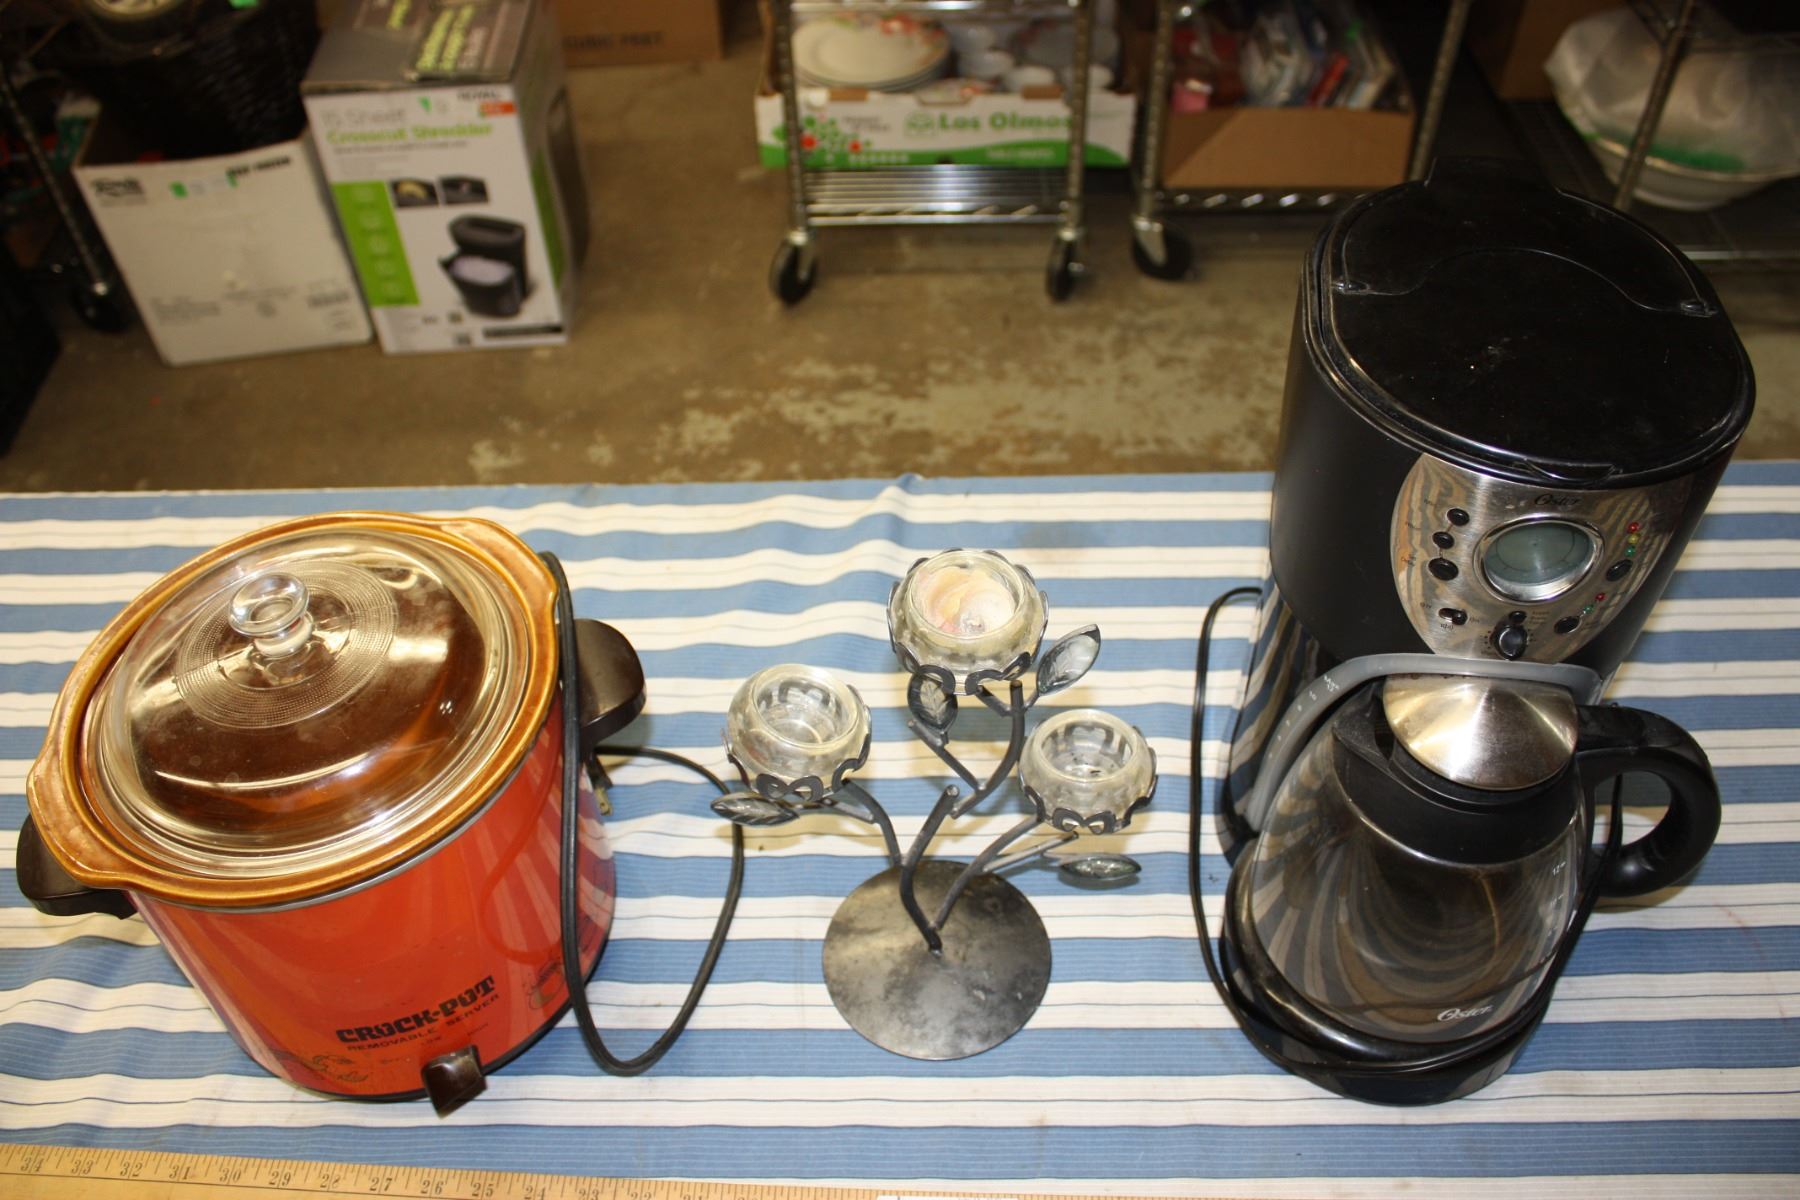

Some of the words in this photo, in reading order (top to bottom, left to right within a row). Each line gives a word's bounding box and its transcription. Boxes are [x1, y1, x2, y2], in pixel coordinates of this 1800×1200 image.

[326, 127, 407, 144] Crosscut
[413, 122, 493, 140] Shredder
[938, 110, 981, 131] Los
[335, 975, 496, 1043] CROCK-POT
[346, 1026, 438, 1051] REMOVABLE
[445, 994, 500, 1027] SERVER
[1437, 1005, 1493, 1022] Oster
[20, 1156, 44, 1174] 34
[70, 1159, 93, 1176] 33
[119, 1161, 143, 1178] 32
[168, 1164, 191, 1181] 31
[219, 1167, 242, 1184] 30
[269, 1170, 292, 1187] 29
[319, 1173, 341, 1190] 28
[369, 1176, 393, 1192] 27
[421, 1179, 445, 1196] 26
[470, 1182, 494, 1198] 25
[523, 1185, 547, 1200] 24
[577, 1187, 600, 1200] 23
